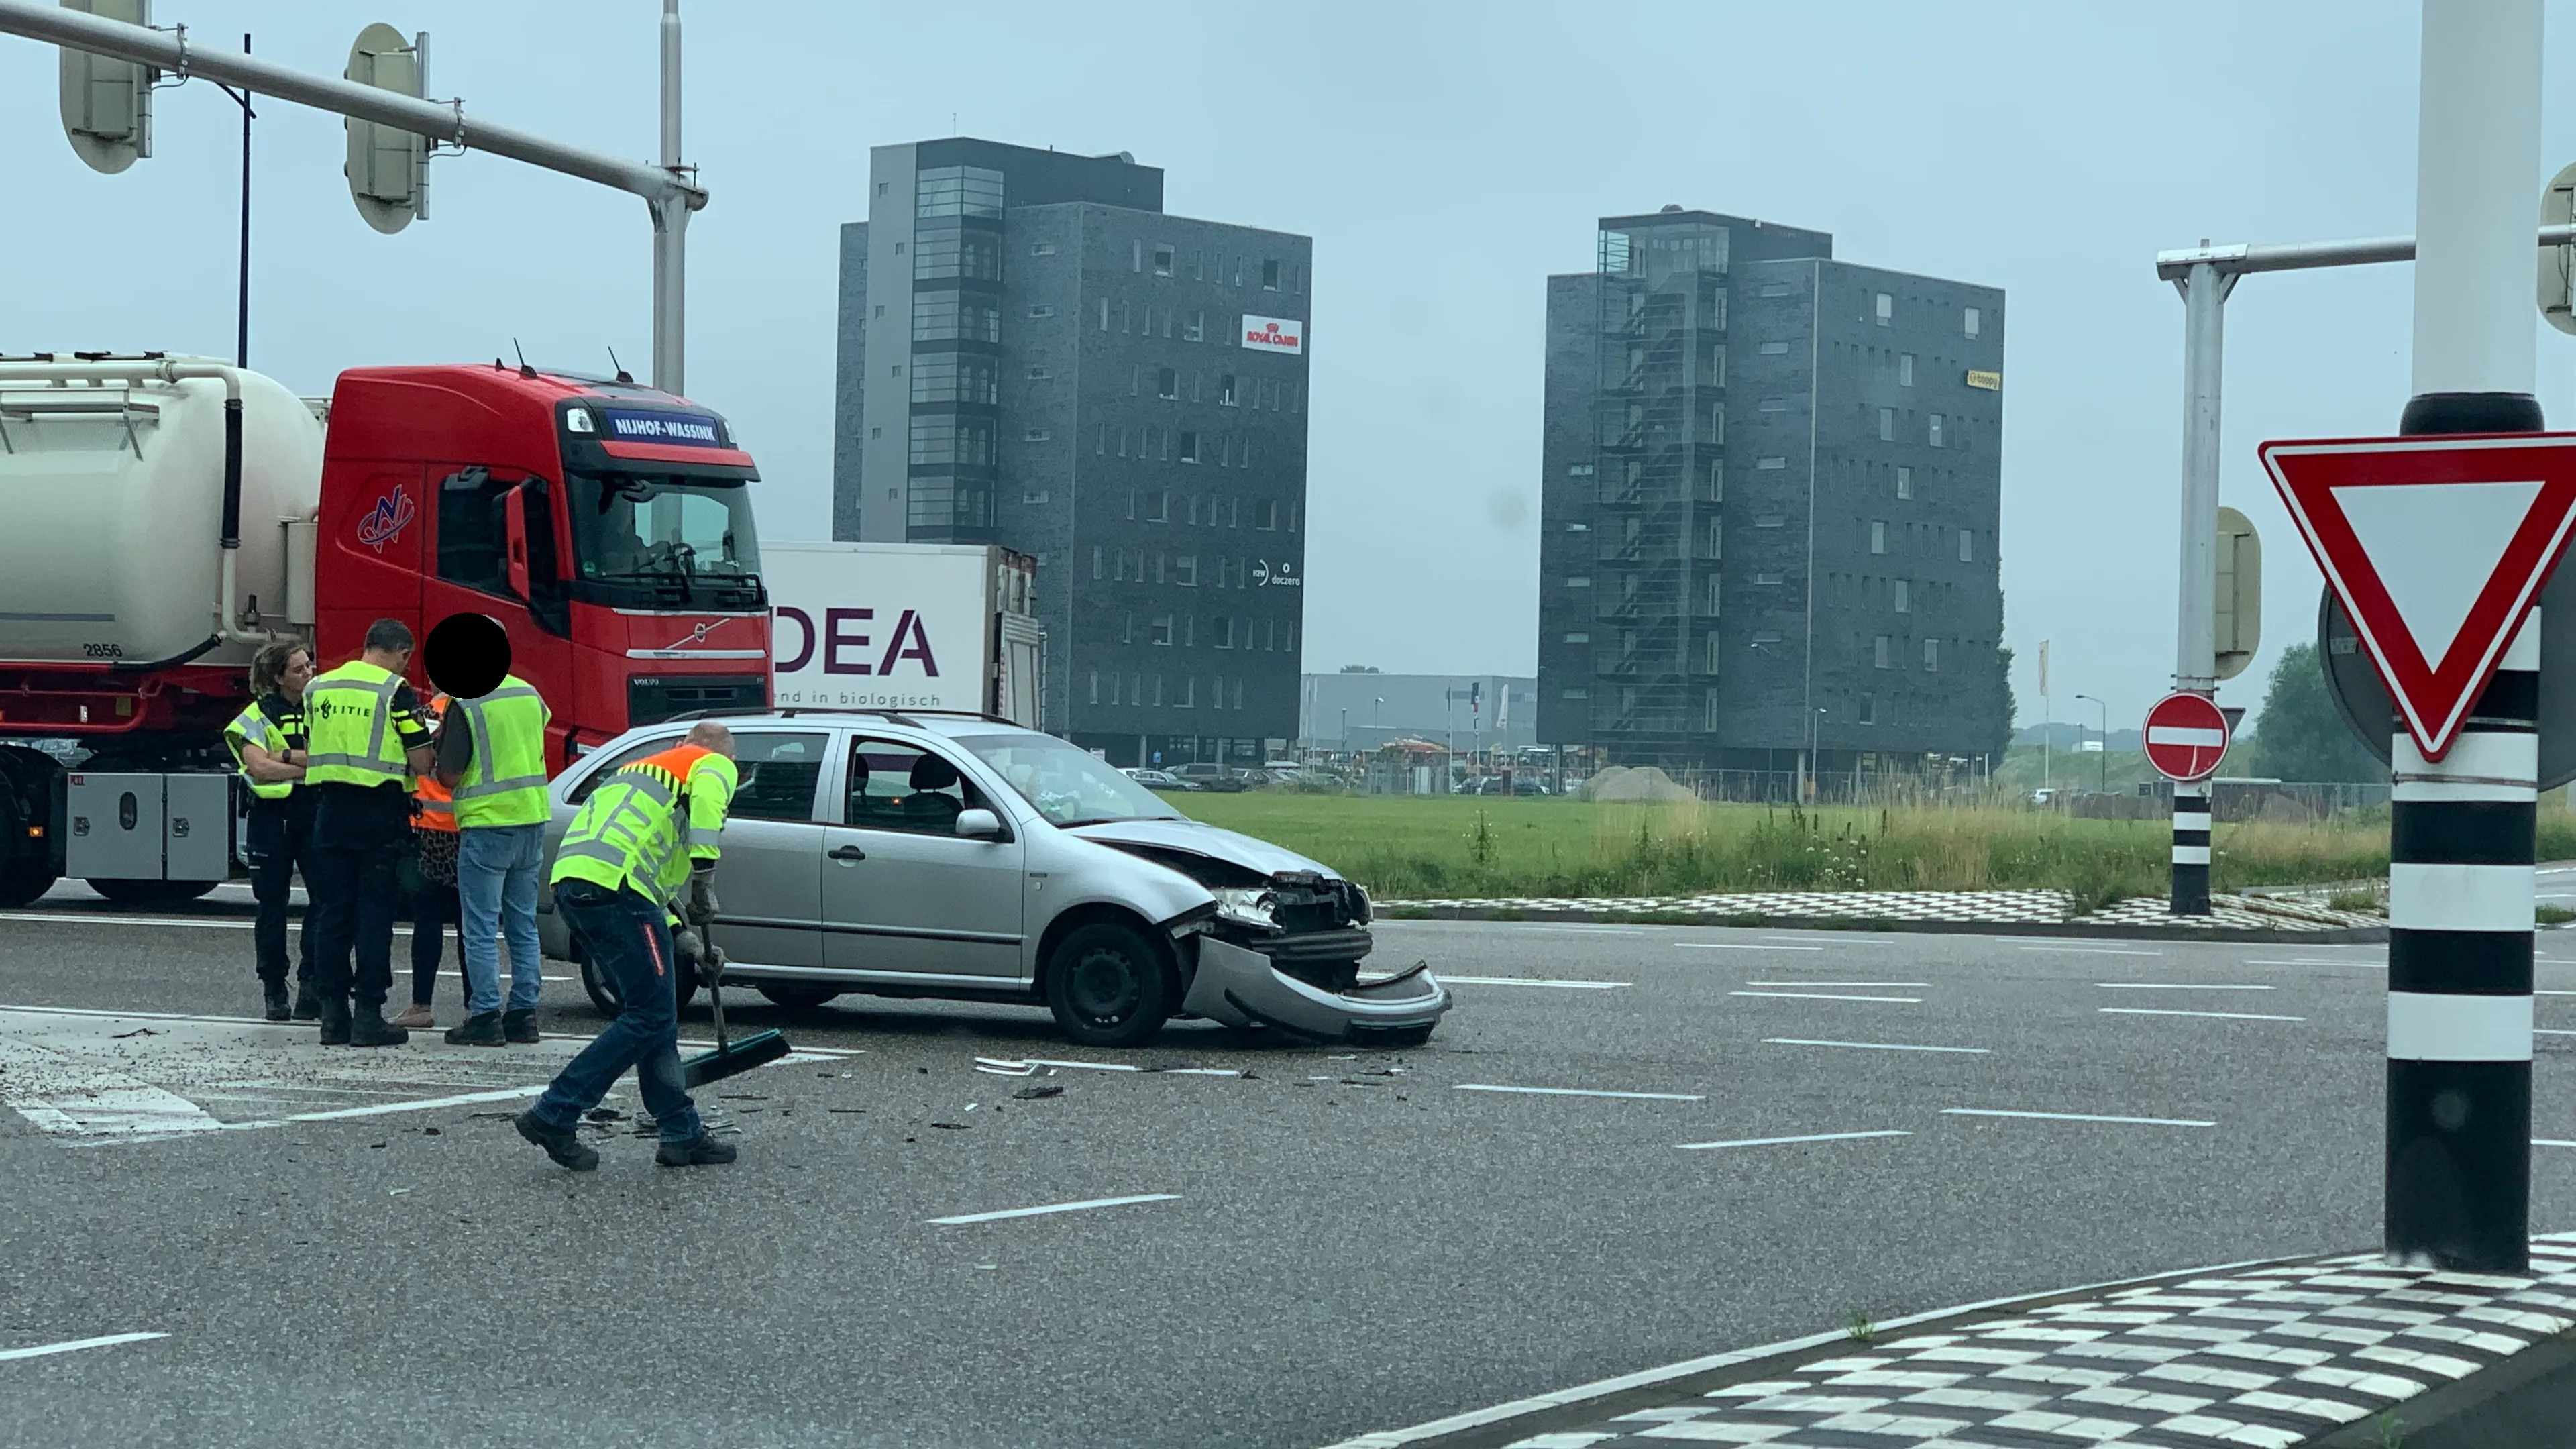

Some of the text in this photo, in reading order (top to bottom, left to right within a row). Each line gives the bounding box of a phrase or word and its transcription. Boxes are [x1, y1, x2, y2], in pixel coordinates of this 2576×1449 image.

[615, 419, 716, 441] NIJHOF-WASSINK
[1271, 574, 1300, 586] doczero
[83, 643, 123, 657] 2856
[812, 691, 828, 703] in
[840, 692, 940, 708] biologisch
[314, 700, 371, 720] POLITIE
